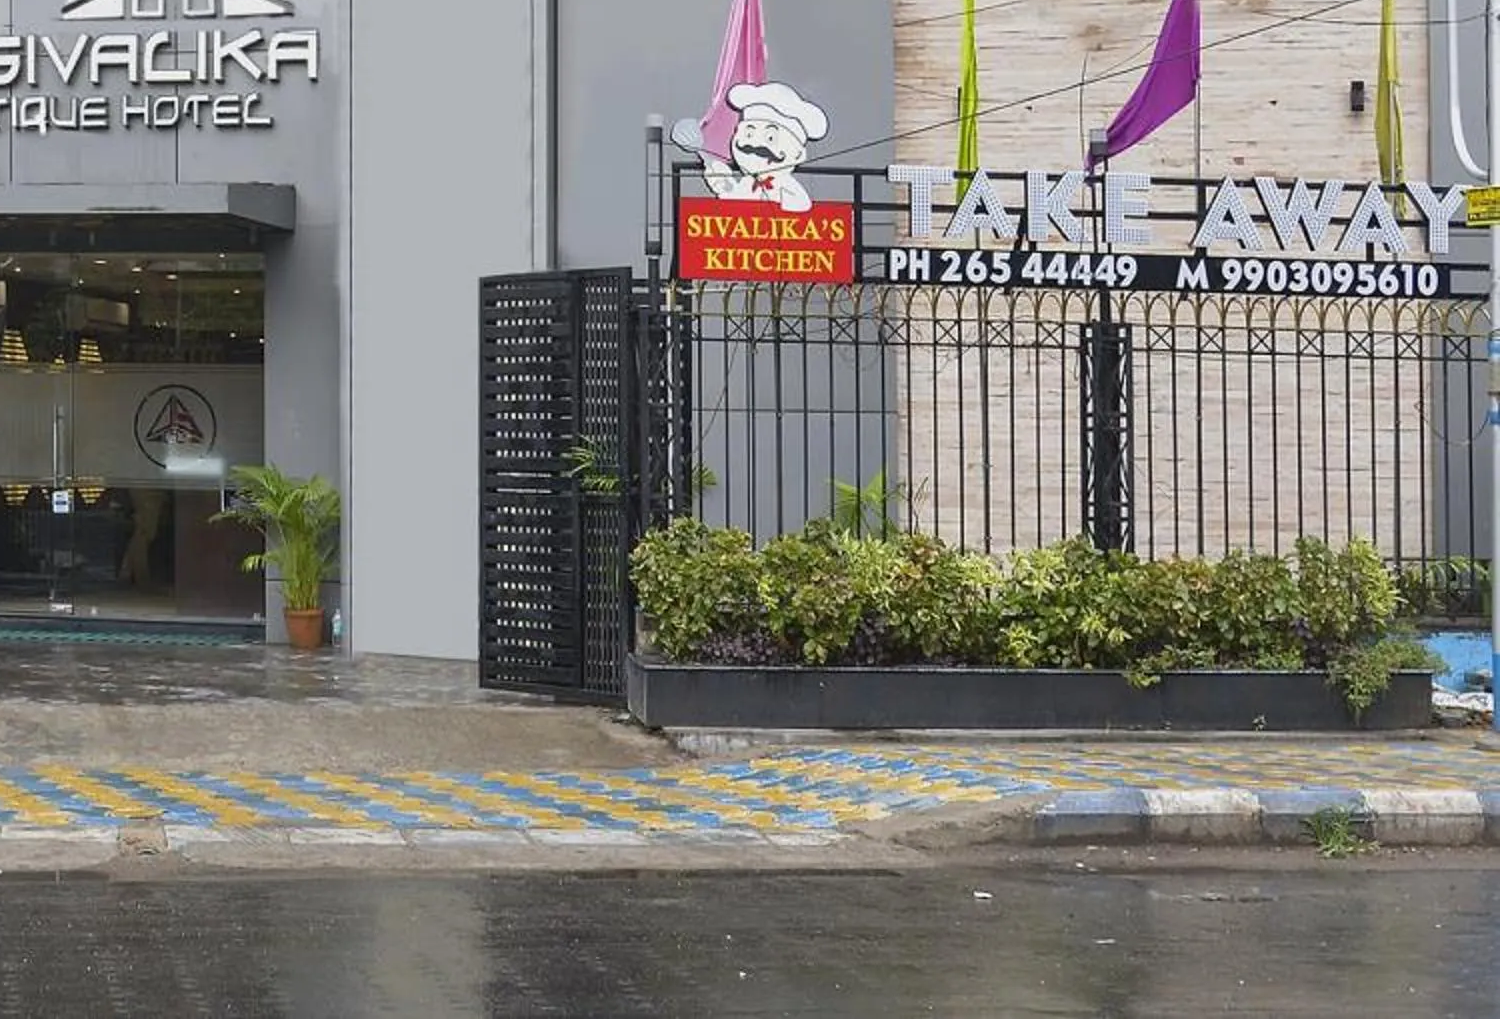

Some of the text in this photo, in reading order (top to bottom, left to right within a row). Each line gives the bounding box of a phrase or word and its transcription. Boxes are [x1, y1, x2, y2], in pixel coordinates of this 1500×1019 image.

[122, 93, 274, 128] HOTEL
[886, 164, 1154, 243] TAKE
[1190, 174, 1468, 255] AWAY
[687, 214, 845, 241] SIVALIKA'S
[704, 247, 836, 273] KITCHEN
[889, 249, 1439, 296] PH 265 44449 M 9903095610
